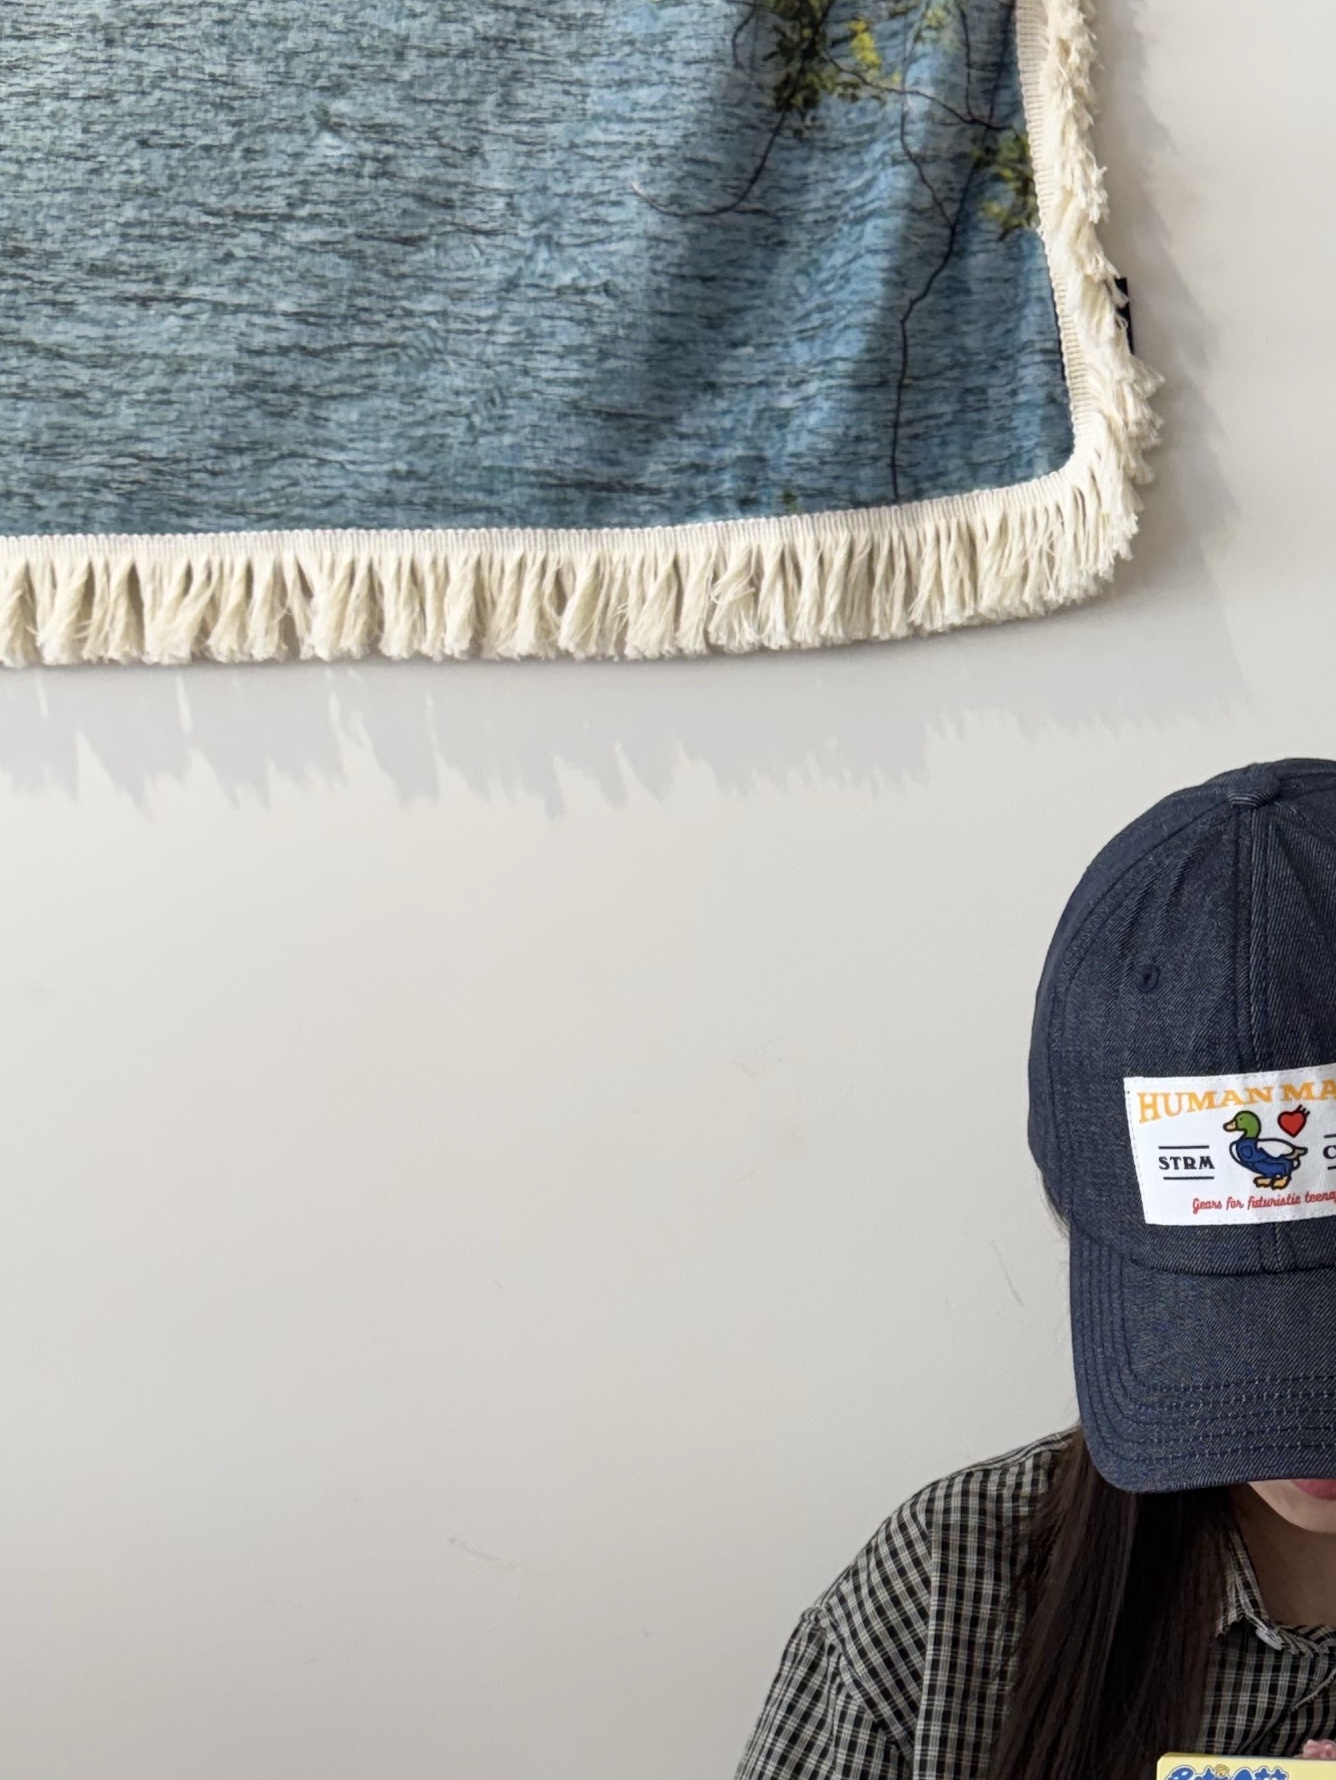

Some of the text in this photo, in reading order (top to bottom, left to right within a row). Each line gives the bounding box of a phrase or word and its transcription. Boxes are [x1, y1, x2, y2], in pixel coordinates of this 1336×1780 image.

[1138, 1086, 1273, 1122] HUMAN
[1158, 1155, 1215, 1171] STRM
[1192, 1197, 1223, 1215] Gears
[1226, 1196, 1245, 1211] for
[1247, 1193, 1302, 1211] futuristic
